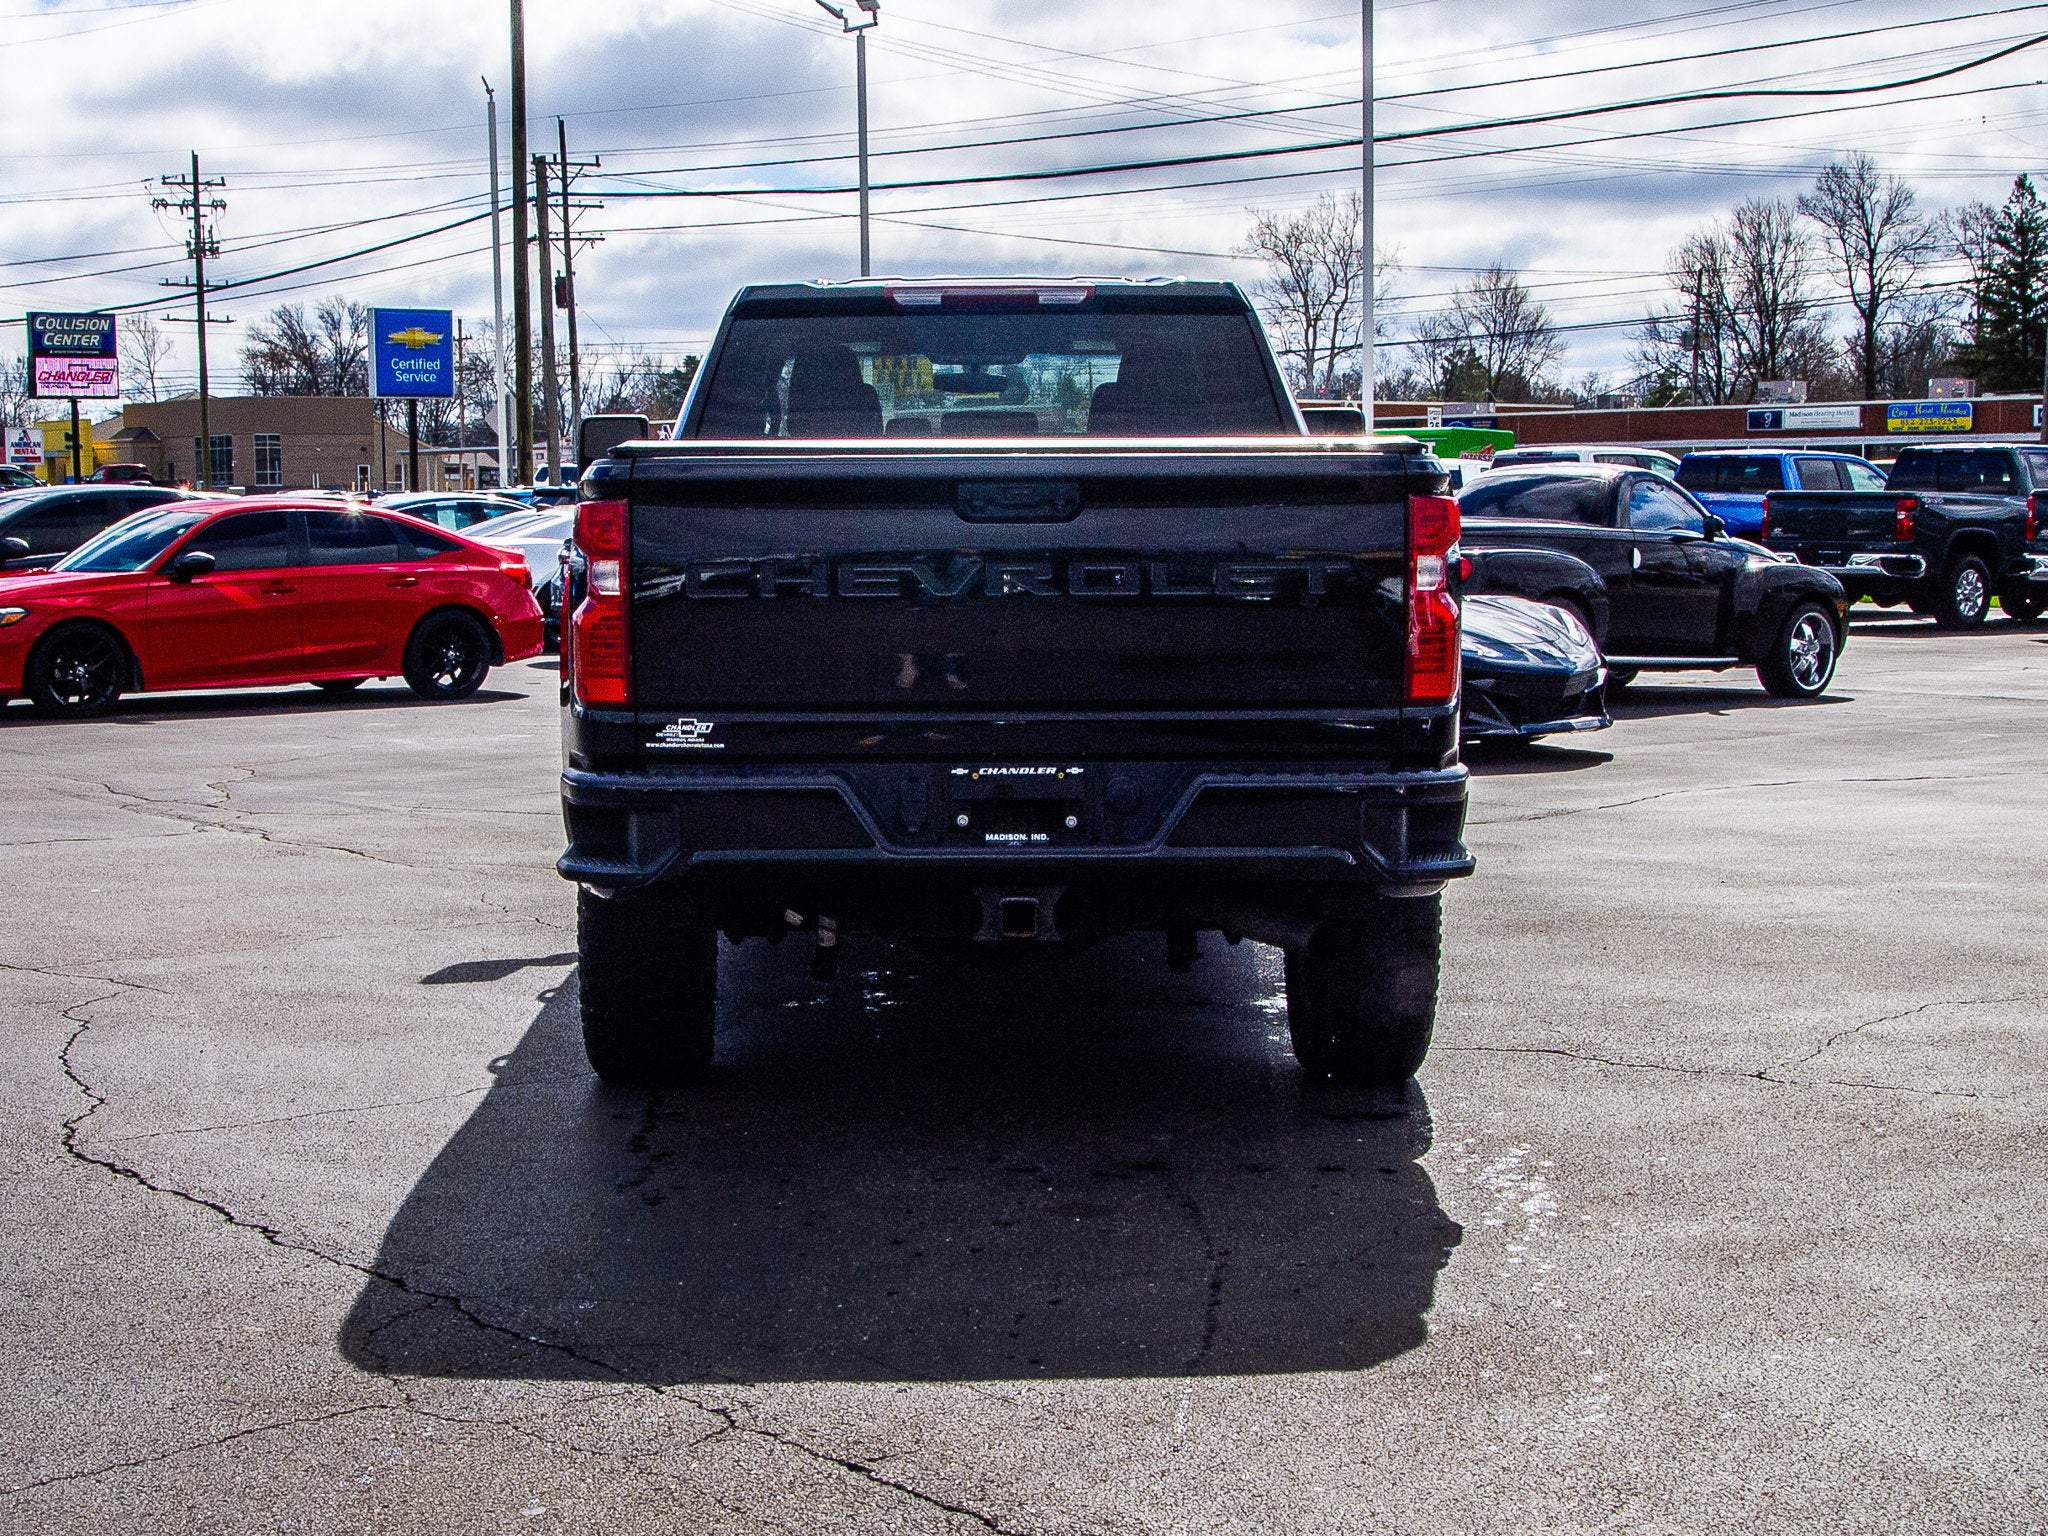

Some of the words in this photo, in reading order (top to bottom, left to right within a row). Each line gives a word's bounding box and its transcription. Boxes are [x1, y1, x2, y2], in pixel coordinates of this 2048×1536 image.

[35, 316, 110, 331] COLLISION
[44, 333, 100, 346] CENTER
[391, 358, 441, 370] Certified
[38, 370, 111, 382] CHANDLER
[395, 371, 437, 382] Service
[683, 559, 1353, 599] CHEVROLET
[978, 767, 1057, 775] CHANDLER
[1031, 833, 1049, 841] IND.
